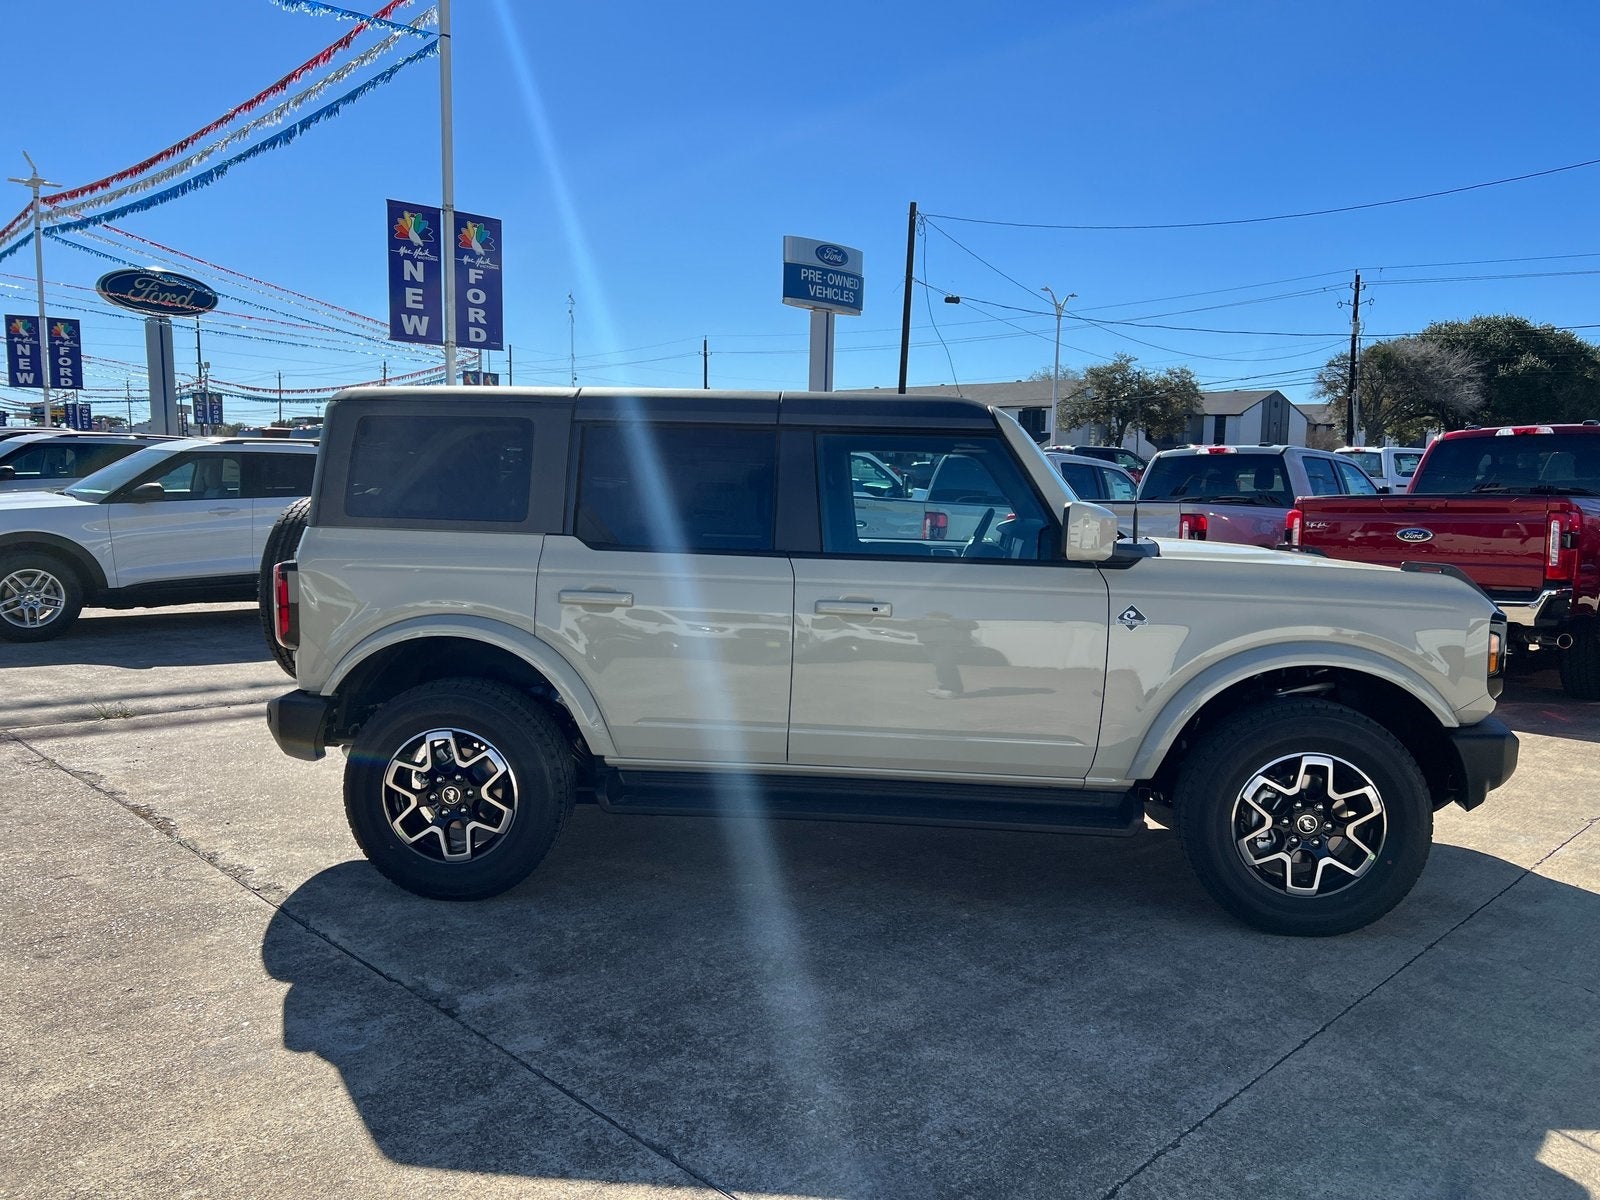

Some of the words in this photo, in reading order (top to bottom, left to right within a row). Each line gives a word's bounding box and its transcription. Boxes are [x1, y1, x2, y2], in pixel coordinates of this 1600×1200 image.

[824, 247, 843, 262] Ford
[127, 277, 195, 307] Ford
[801, 268, 860, 290] PRE-OWNED
[808, 284, 855, 303] VEHICLES
[401, 259, 430, 337] NEW
[466, 268, 487, 343] FORD
[16, 343, 35, 384] NEW
[58, 346, 73, 387] FORD
[1403, 530, 1424, 540] Ford
